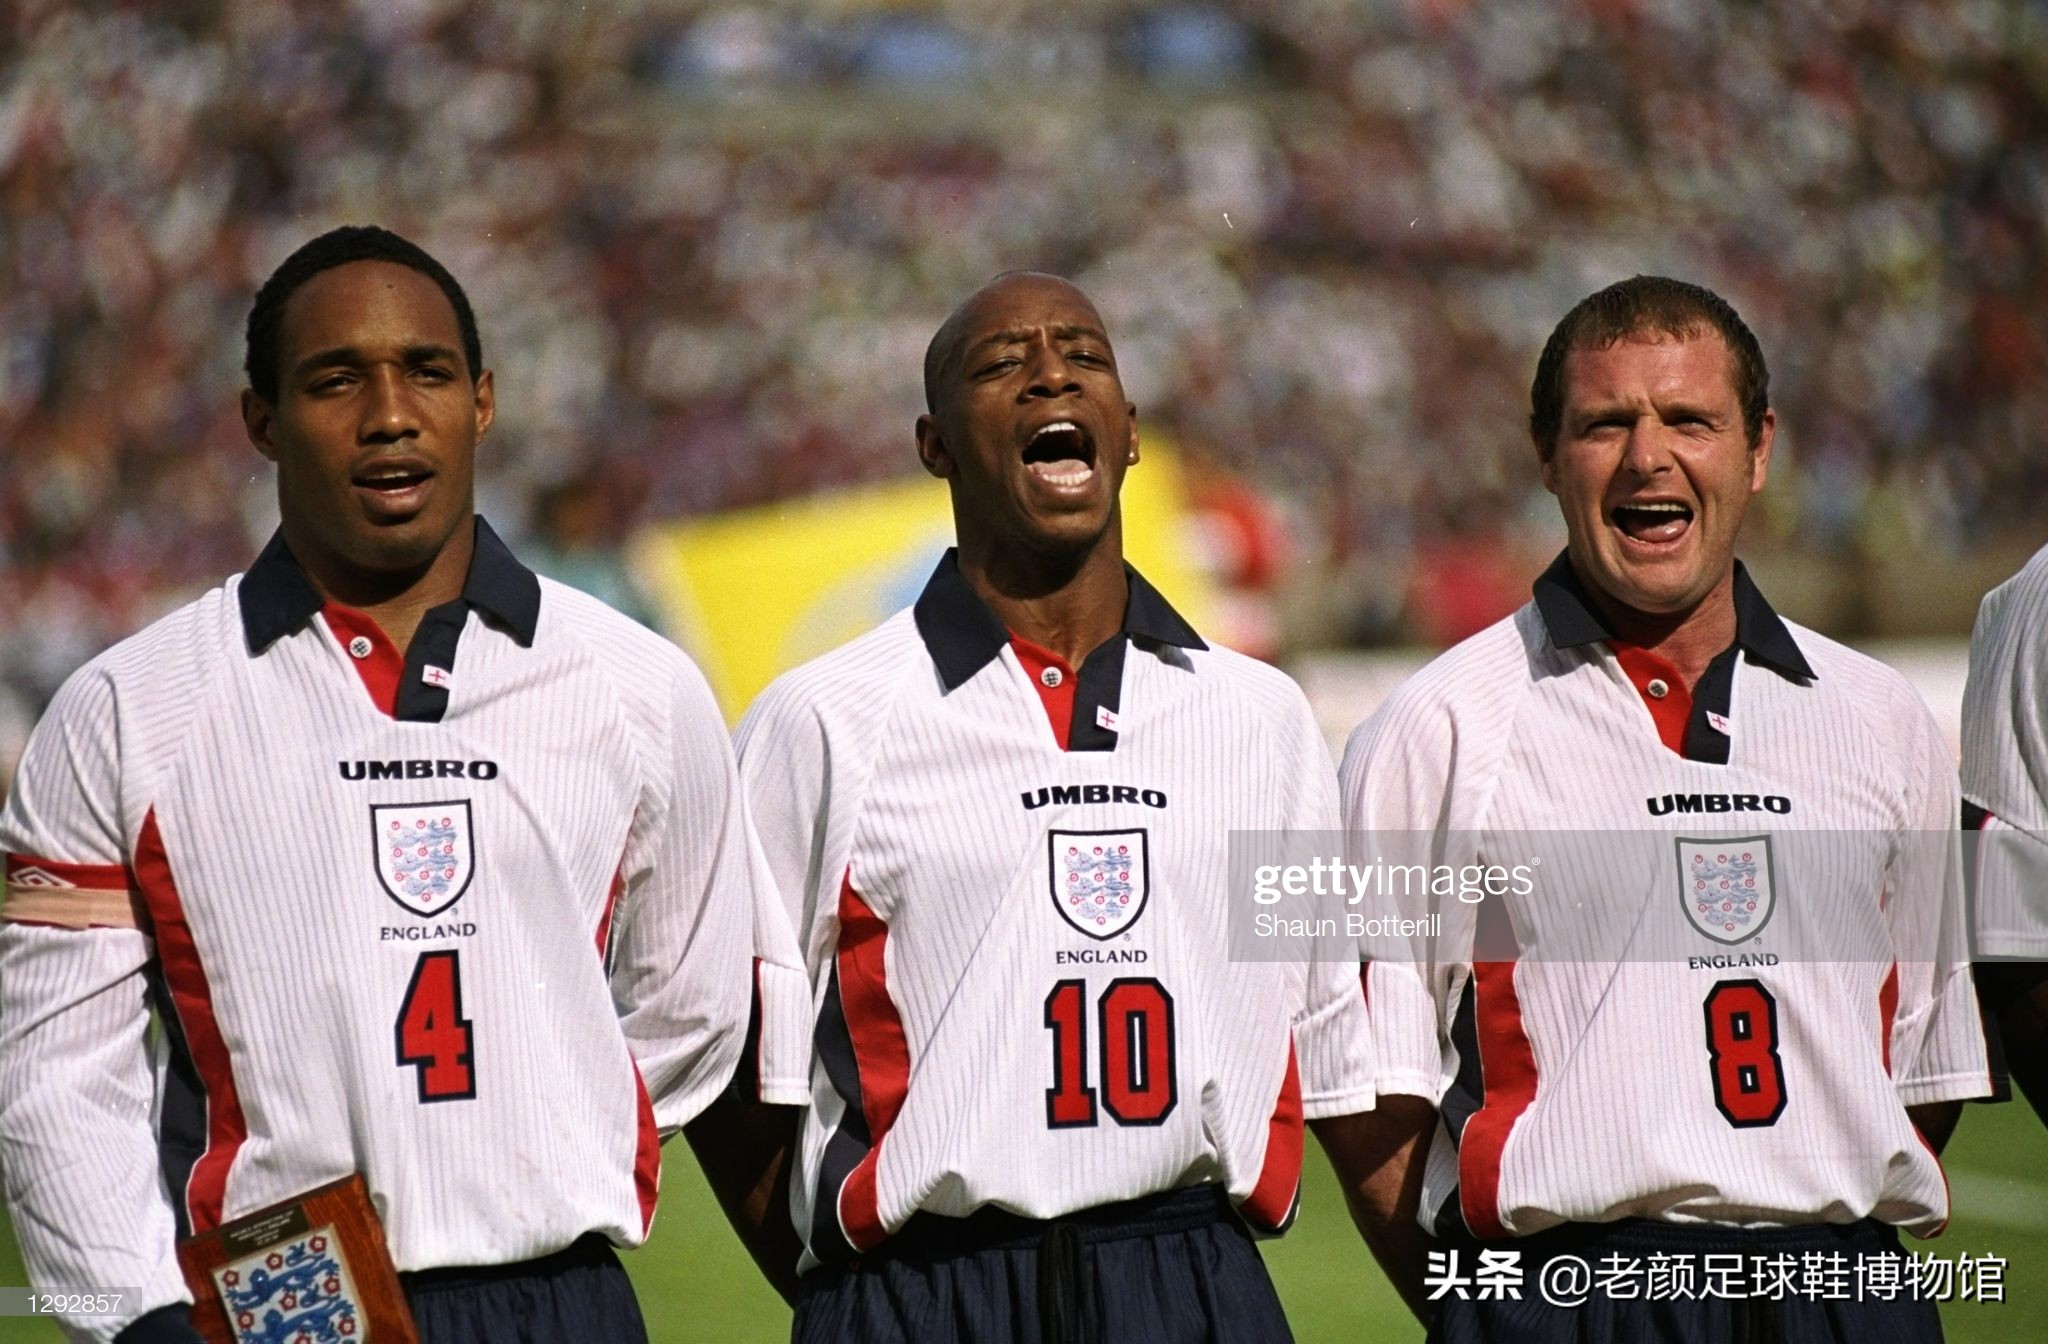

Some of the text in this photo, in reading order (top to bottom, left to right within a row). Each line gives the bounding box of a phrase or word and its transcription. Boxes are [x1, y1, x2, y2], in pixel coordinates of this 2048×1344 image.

[338, 760, 498, 780] UMBRO
[1021, 785, 1167, 810] UMBRO
[1647, 794, 1791, 816] UMBRO
[380, 922, 476, 941] ENGLAND
[1056, 950, 1147, 964] ENGLAND
[1688, 952, 1779, 970] ENGLAND
[394, 949, 477, 1104] 4
[1044, 977, 1178, 1130] 10
[1703, 978, 1788, 1129] 8
